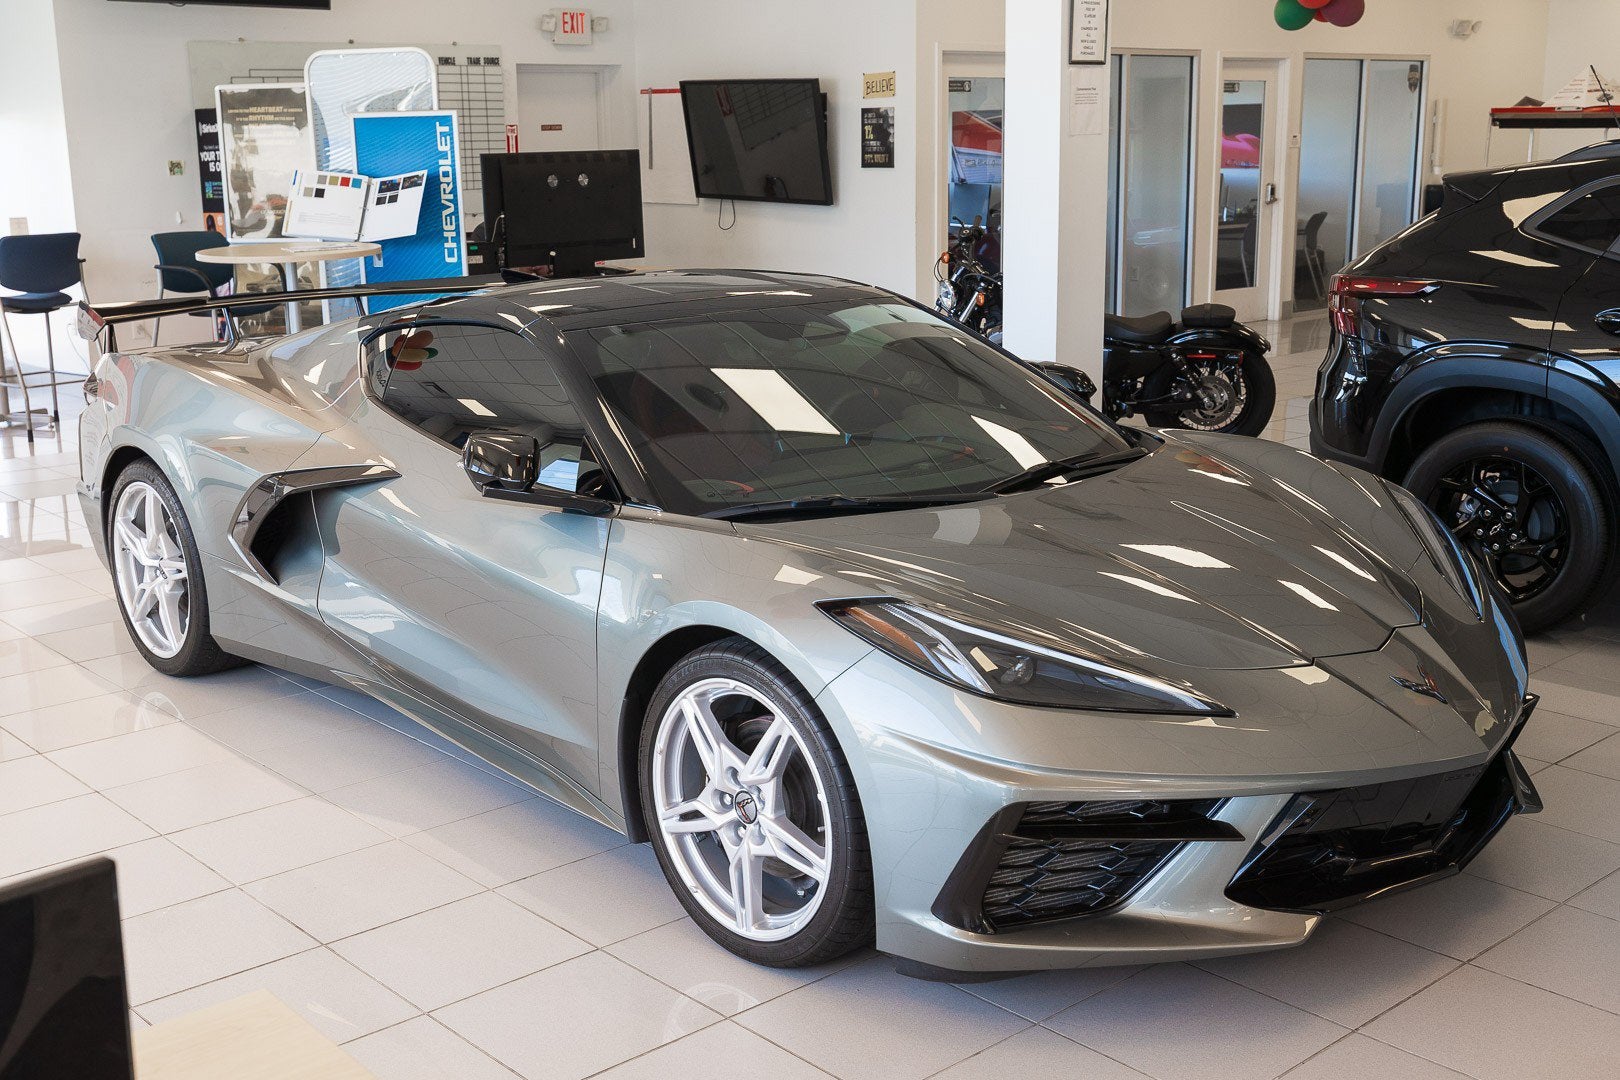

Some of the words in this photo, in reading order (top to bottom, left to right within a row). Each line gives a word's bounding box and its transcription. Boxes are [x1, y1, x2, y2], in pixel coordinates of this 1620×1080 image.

[562, 12, 585, 34] EXIT
[438, 57, 456, 66] VEHICLE
[467, 57, 481, 65] TRADE
[483, 57, 500, 66] SOURCE
[865, 78, 894, 95] BELIEVE
[200, 151, 216, 162] YOUR
[209, 162, 216, 172] IS
[436, 121, 458, 263] CHEVROLET
